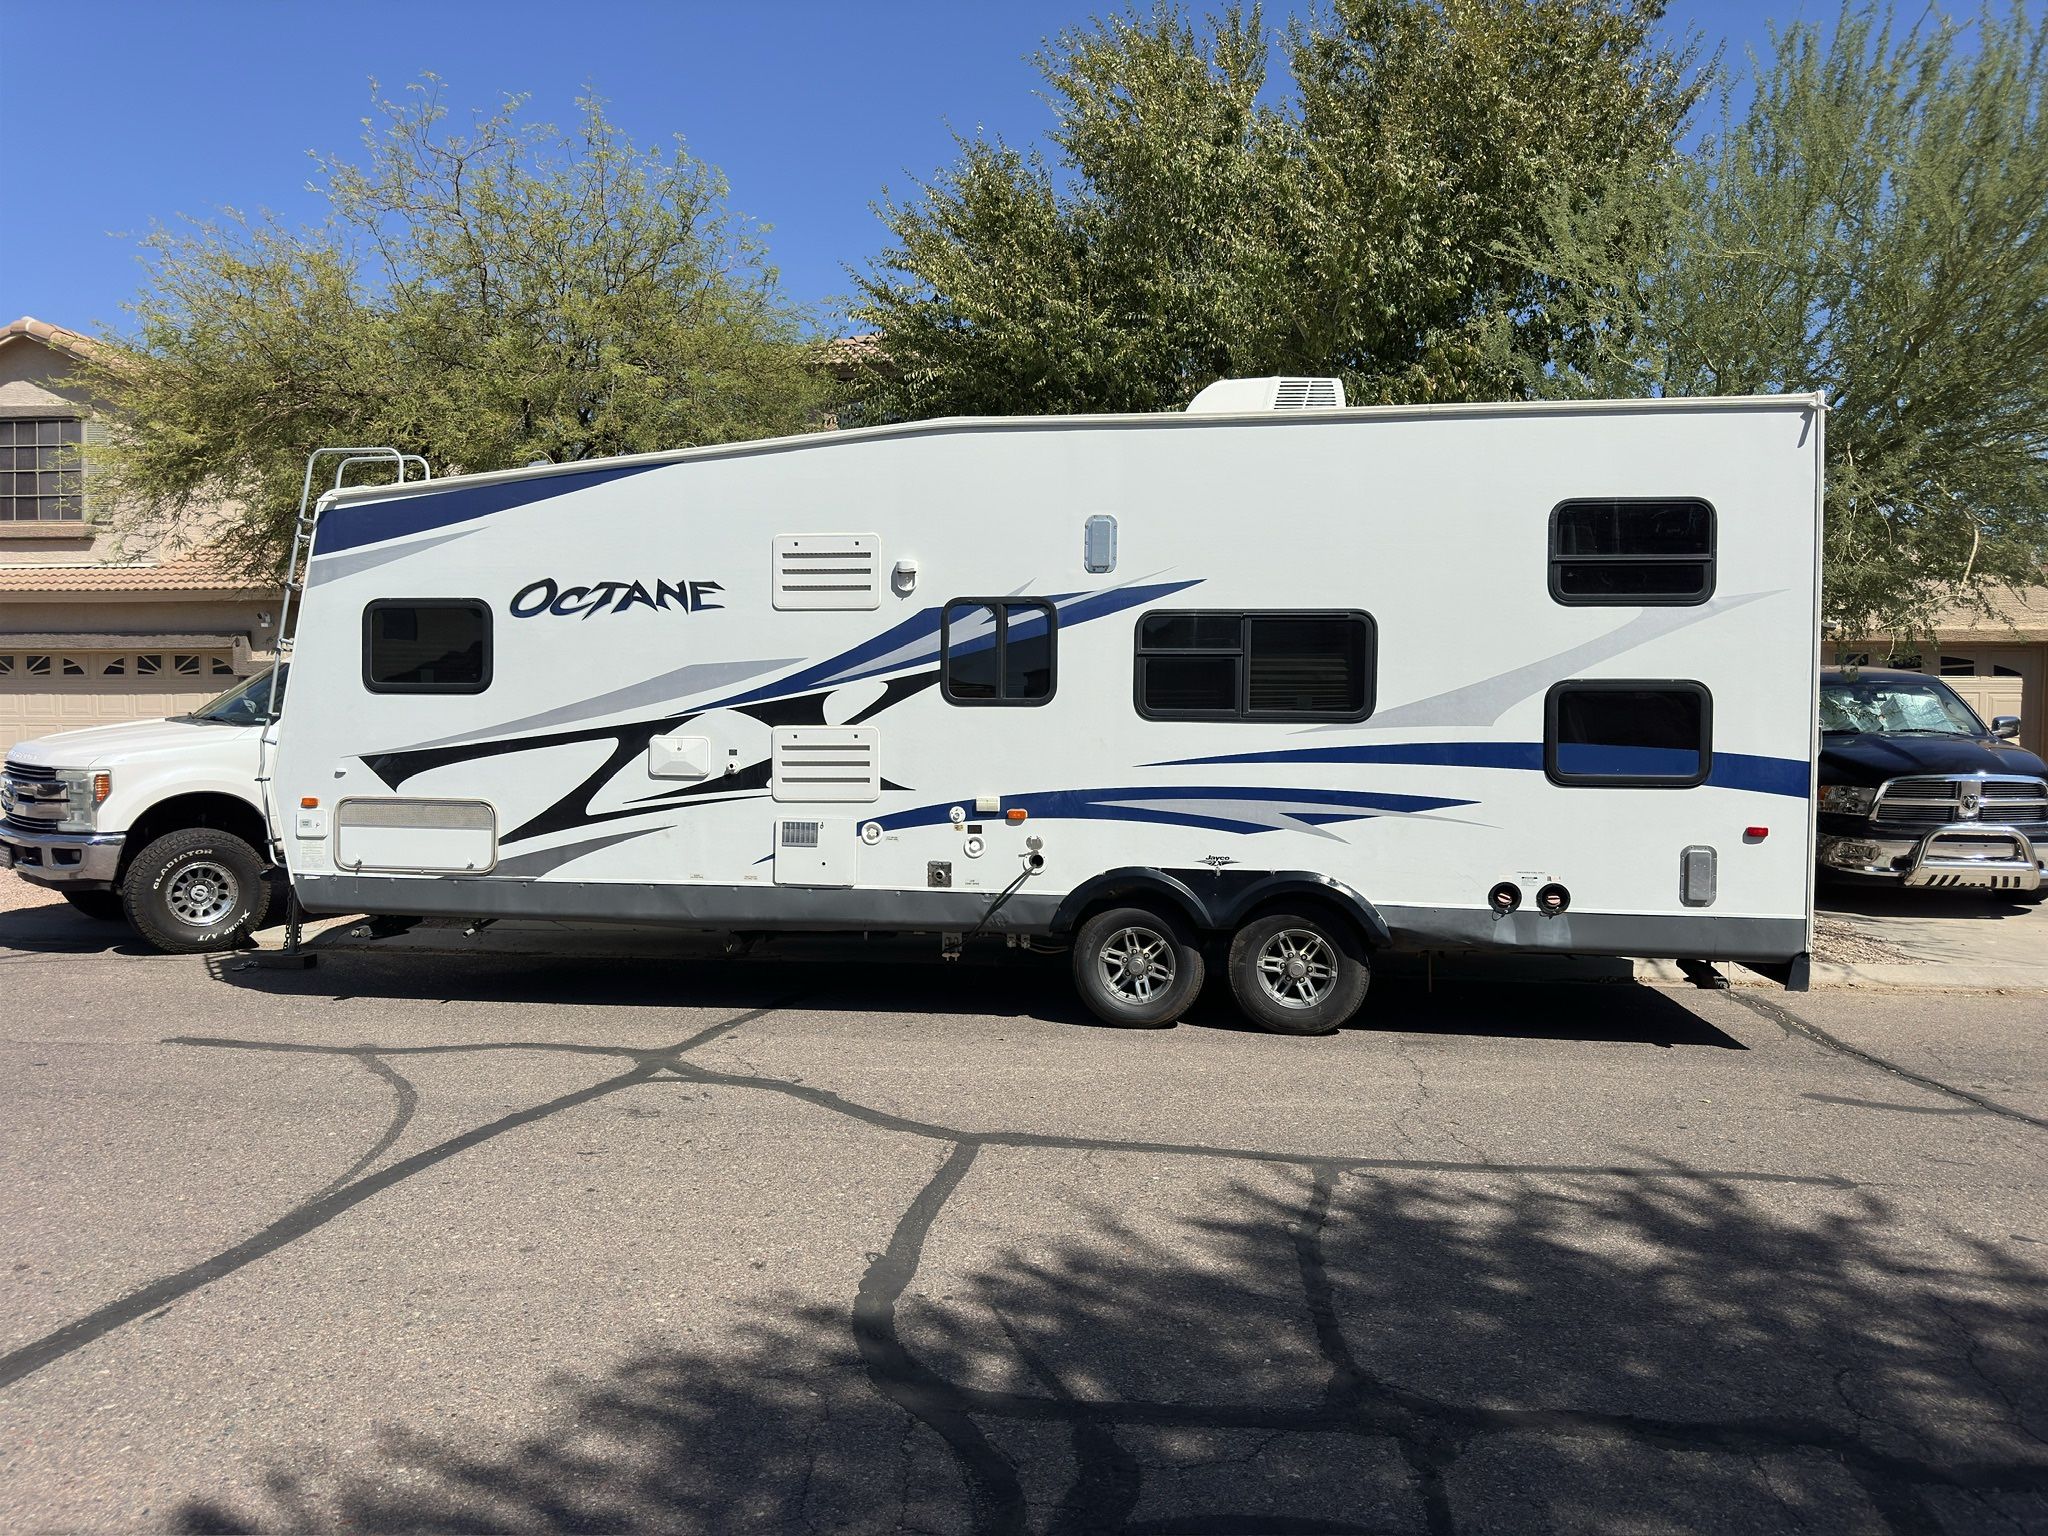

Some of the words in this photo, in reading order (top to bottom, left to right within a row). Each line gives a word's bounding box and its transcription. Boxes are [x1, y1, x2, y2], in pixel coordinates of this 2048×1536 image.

[509, 577, 726, 621] OCTANE
[153, 849, 213, 890] GLADIATOR
[197, 932, 218, 942] A/T
